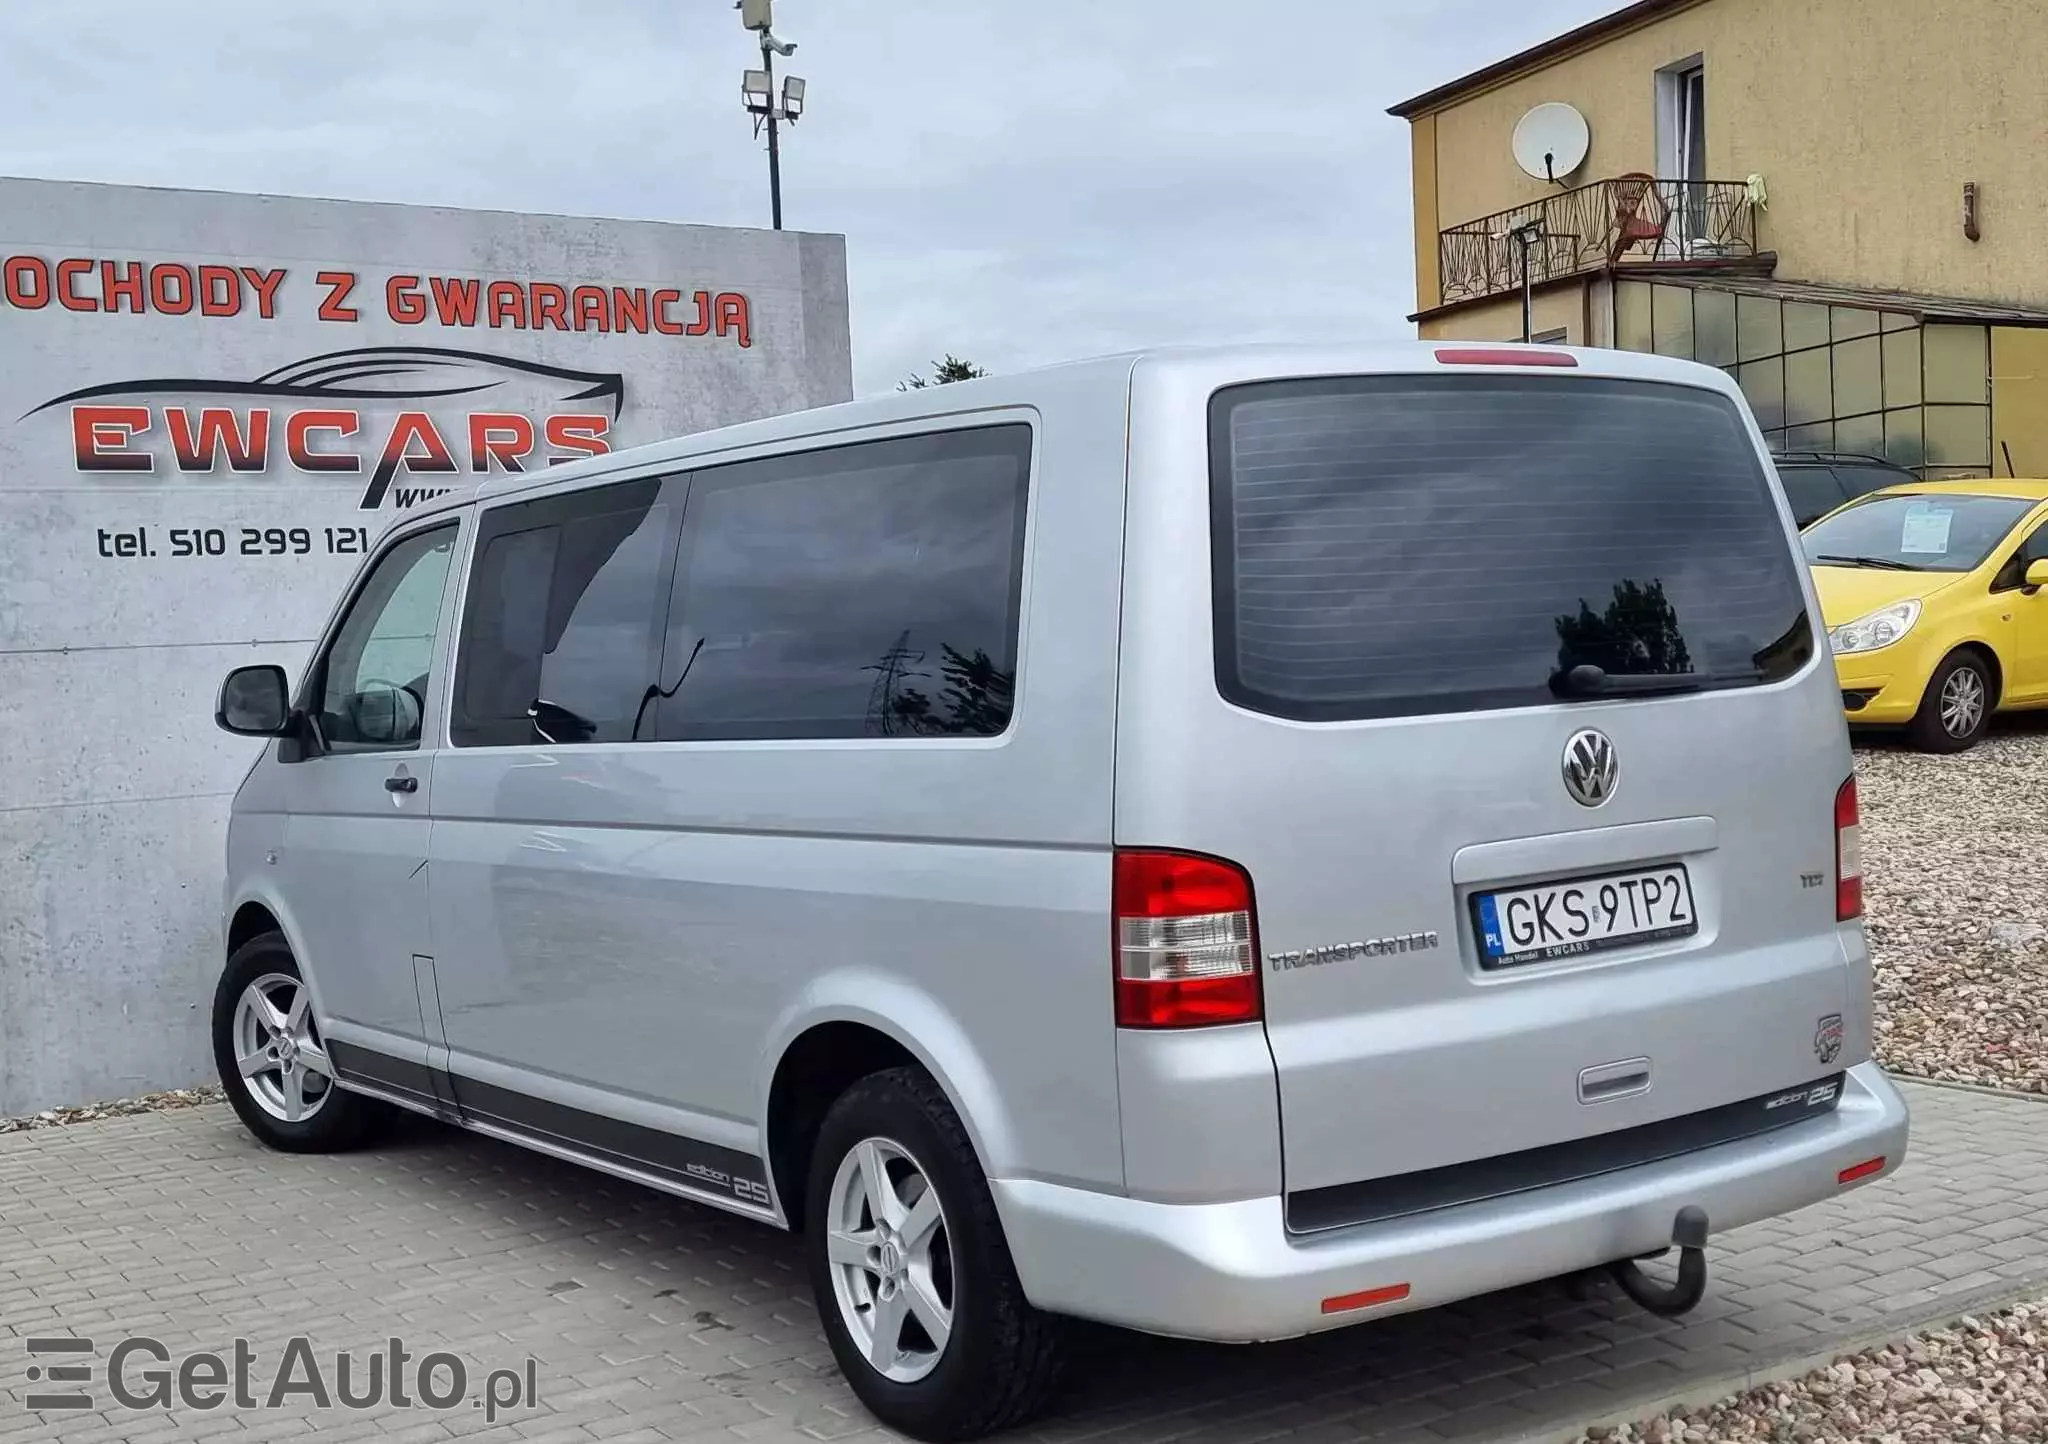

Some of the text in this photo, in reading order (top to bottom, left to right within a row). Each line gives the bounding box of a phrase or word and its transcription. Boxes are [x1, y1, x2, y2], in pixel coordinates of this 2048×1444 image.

[3, 255, 751, 348] OCHODY Z GWARANCJĄ
[71, 405, 613, 511] EWCARS
[98, 527, 368, 557] tel. 510 299 121
[1506, 889, 1590, 946] GKS
[1600, 874, 1686, 932] 9TP2
[1267, 930, 1438, 971] TRANSPORTER
[1485, 933, 1501, 947] PL
[1546, 942, 1590, 957] EWCARS
[1808, 1082, 1838, 1106] 25
[733, 1177, 770, 1205] 25
